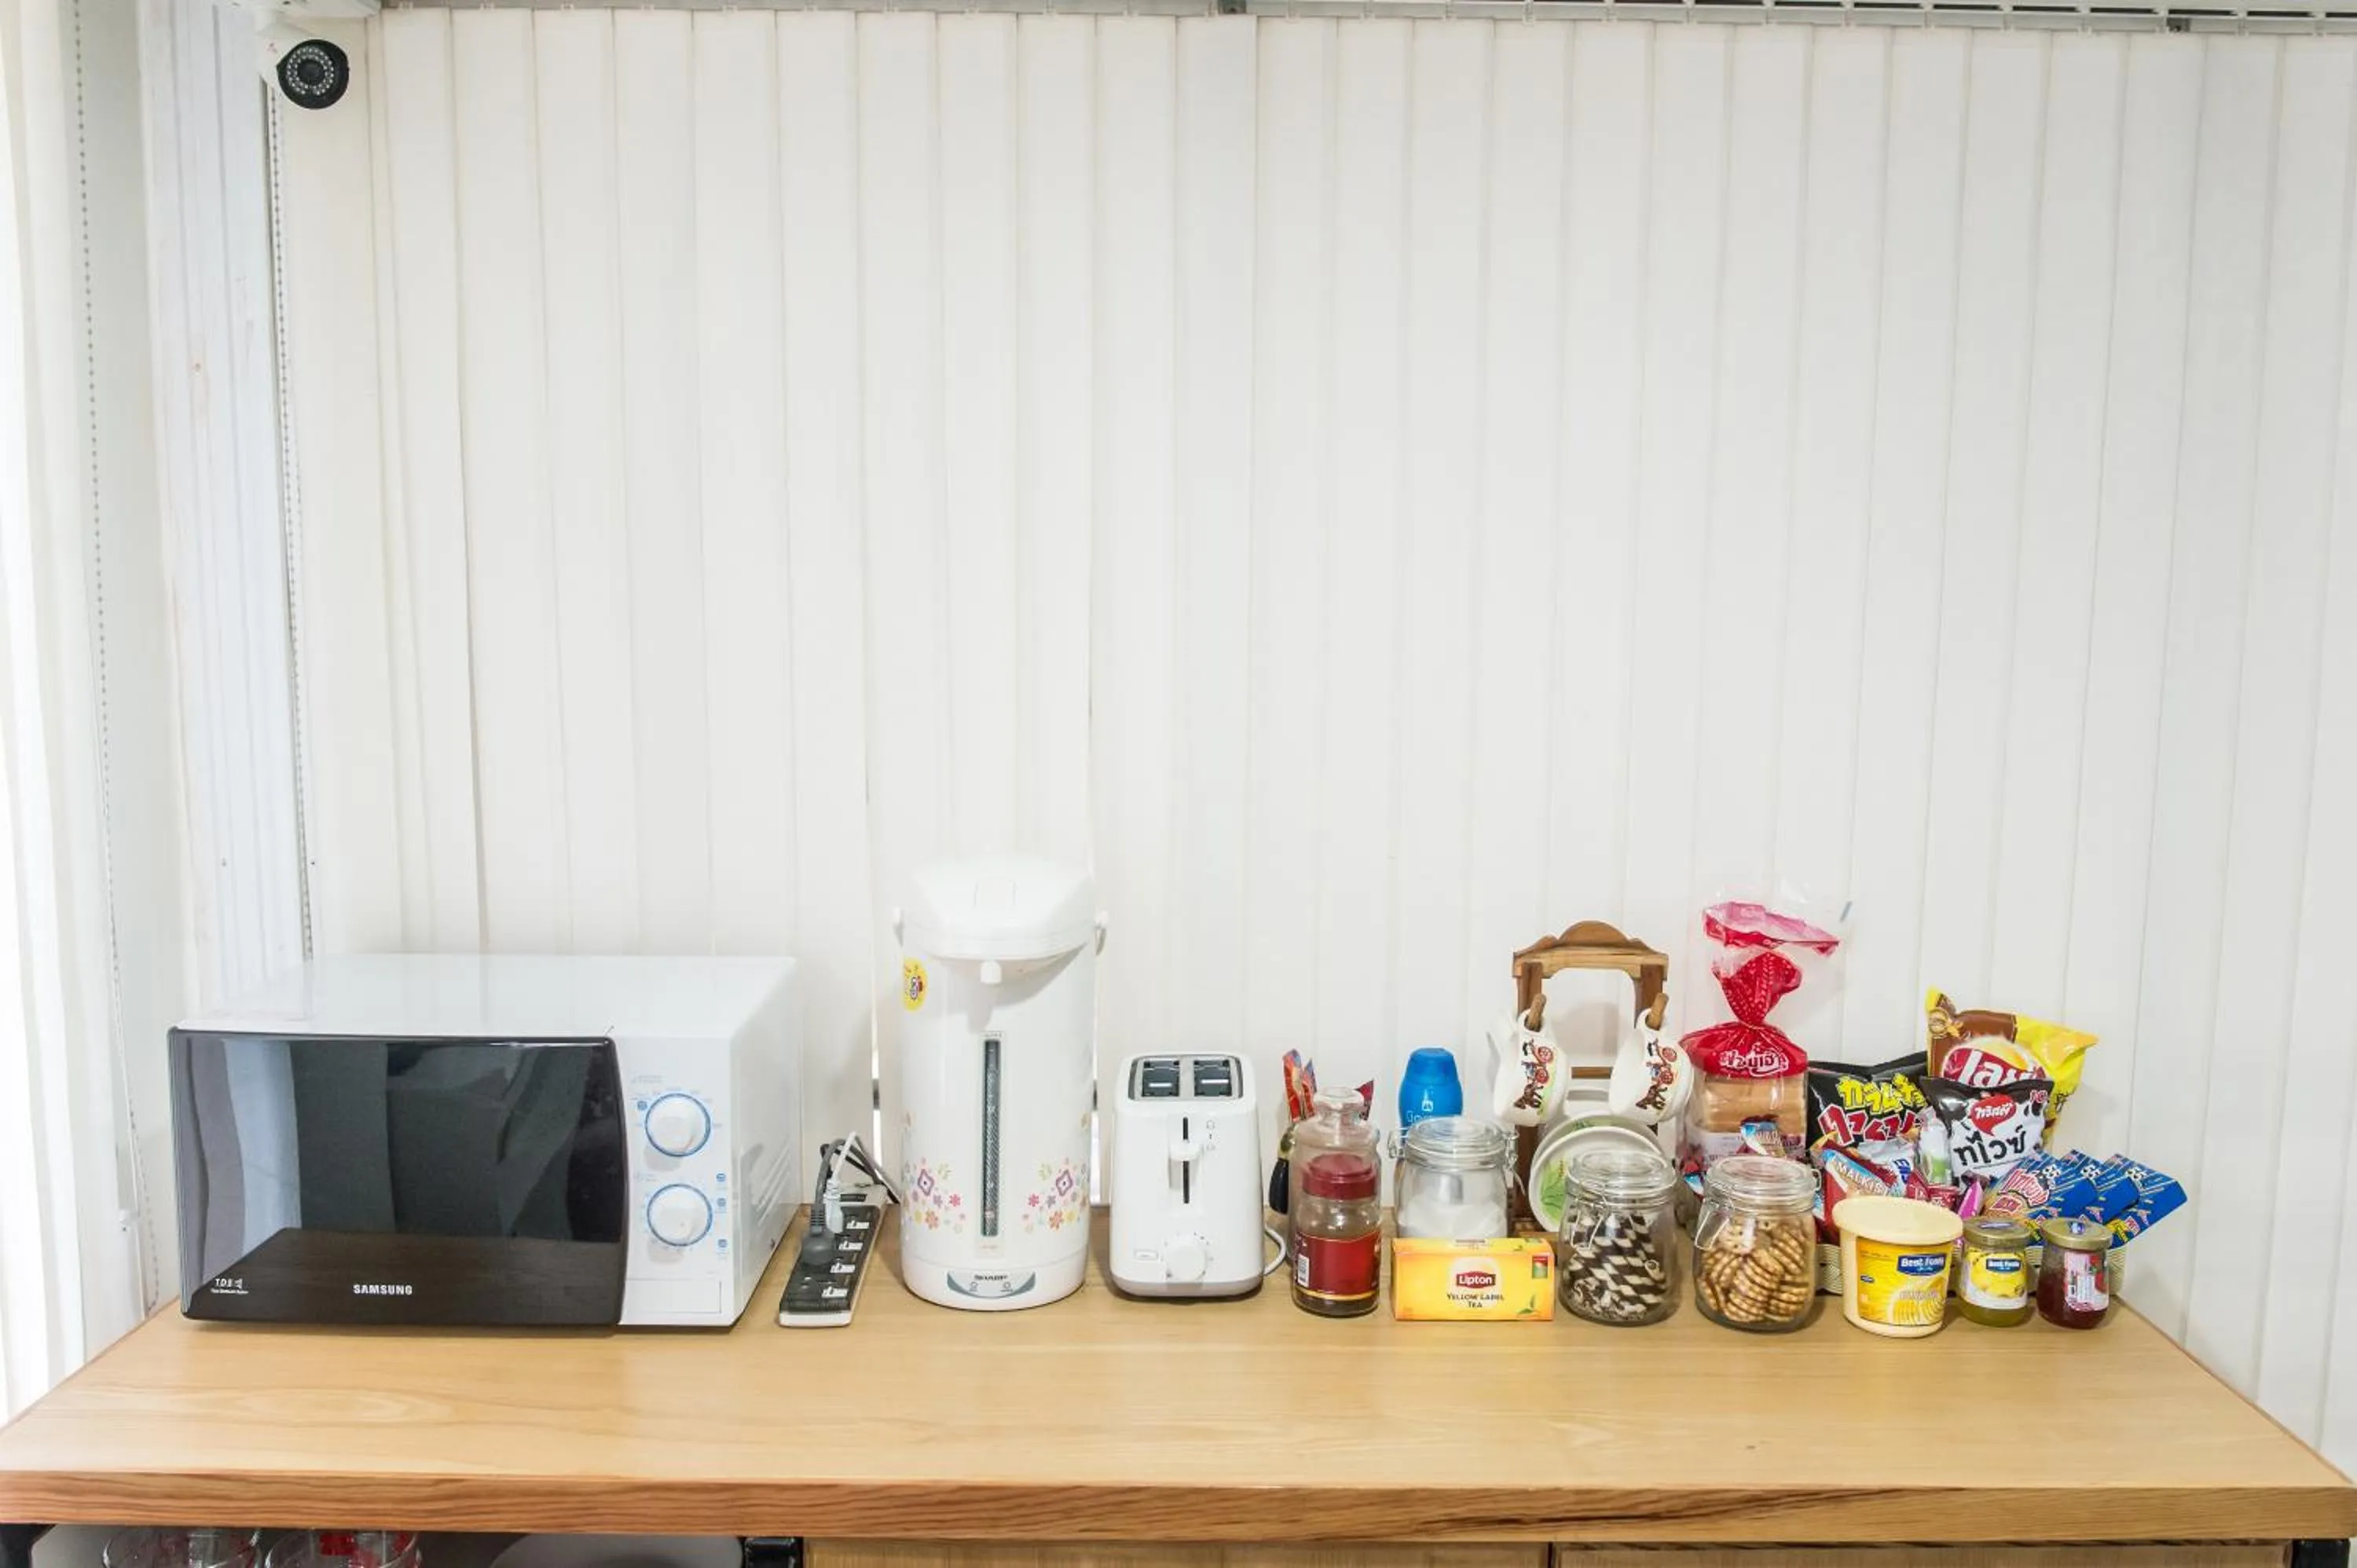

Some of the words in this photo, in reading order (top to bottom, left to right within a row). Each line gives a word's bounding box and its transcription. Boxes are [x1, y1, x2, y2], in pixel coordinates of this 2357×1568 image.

[1458, 1275, 1493, 1286] Lipton
[353, 1284, 413, 1295] SAMSUNG
[1479, 1293, 1505, 1302] LABEL
